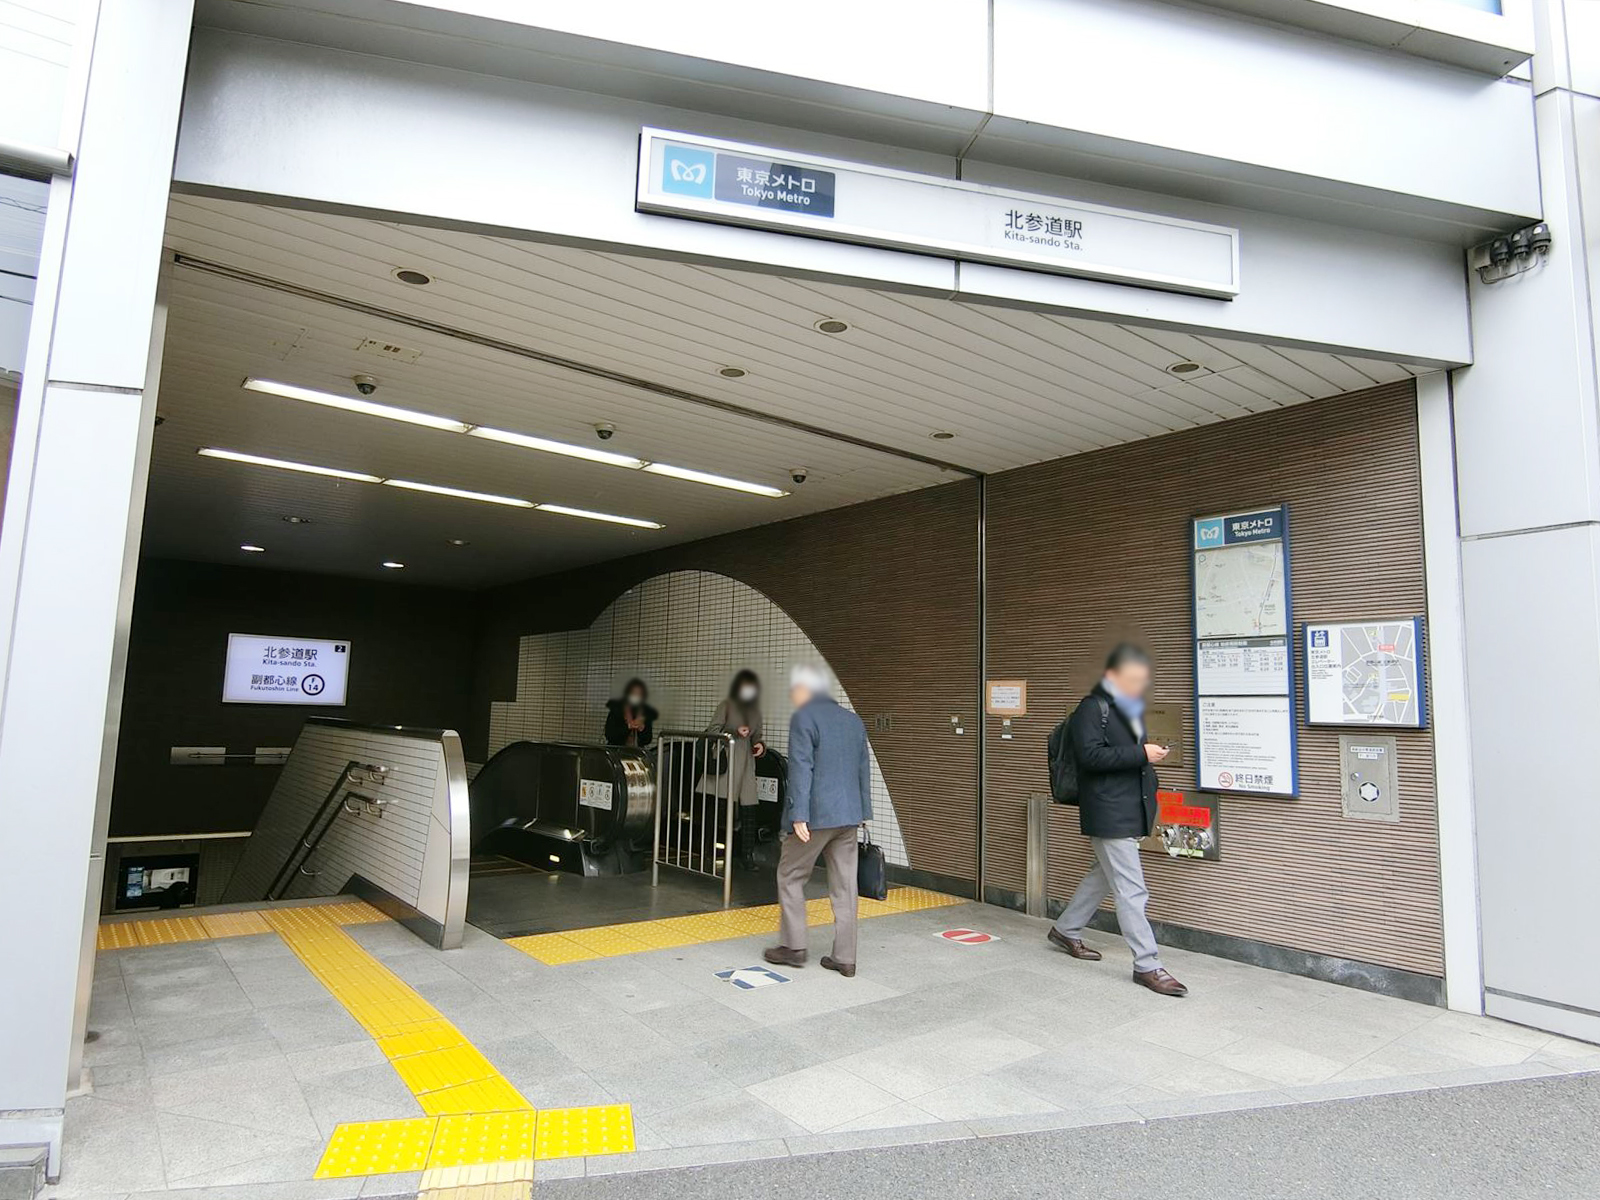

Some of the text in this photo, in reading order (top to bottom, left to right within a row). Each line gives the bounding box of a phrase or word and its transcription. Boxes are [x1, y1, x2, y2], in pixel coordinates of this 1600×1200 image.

[736, 167, 816, 193] 東京メトロ
[741, 184, 811, 205] Tokyo Metro
[1005, 209, 1082, 239] 北参道駅
[1004, 230, 1083, 251] Kita-sando Sta.
[1231, 518, 1273, 531] 東京メトロ
[1234, 527, 1271, 537] Tokyo Metro
[264, 646, 318, 660] 北参道駅
[262, 659, 301, 667] Kita-sando
[251, 674, 298, 686] 副都心線
[1235, 774, 1274, 785] 終日禁煙
